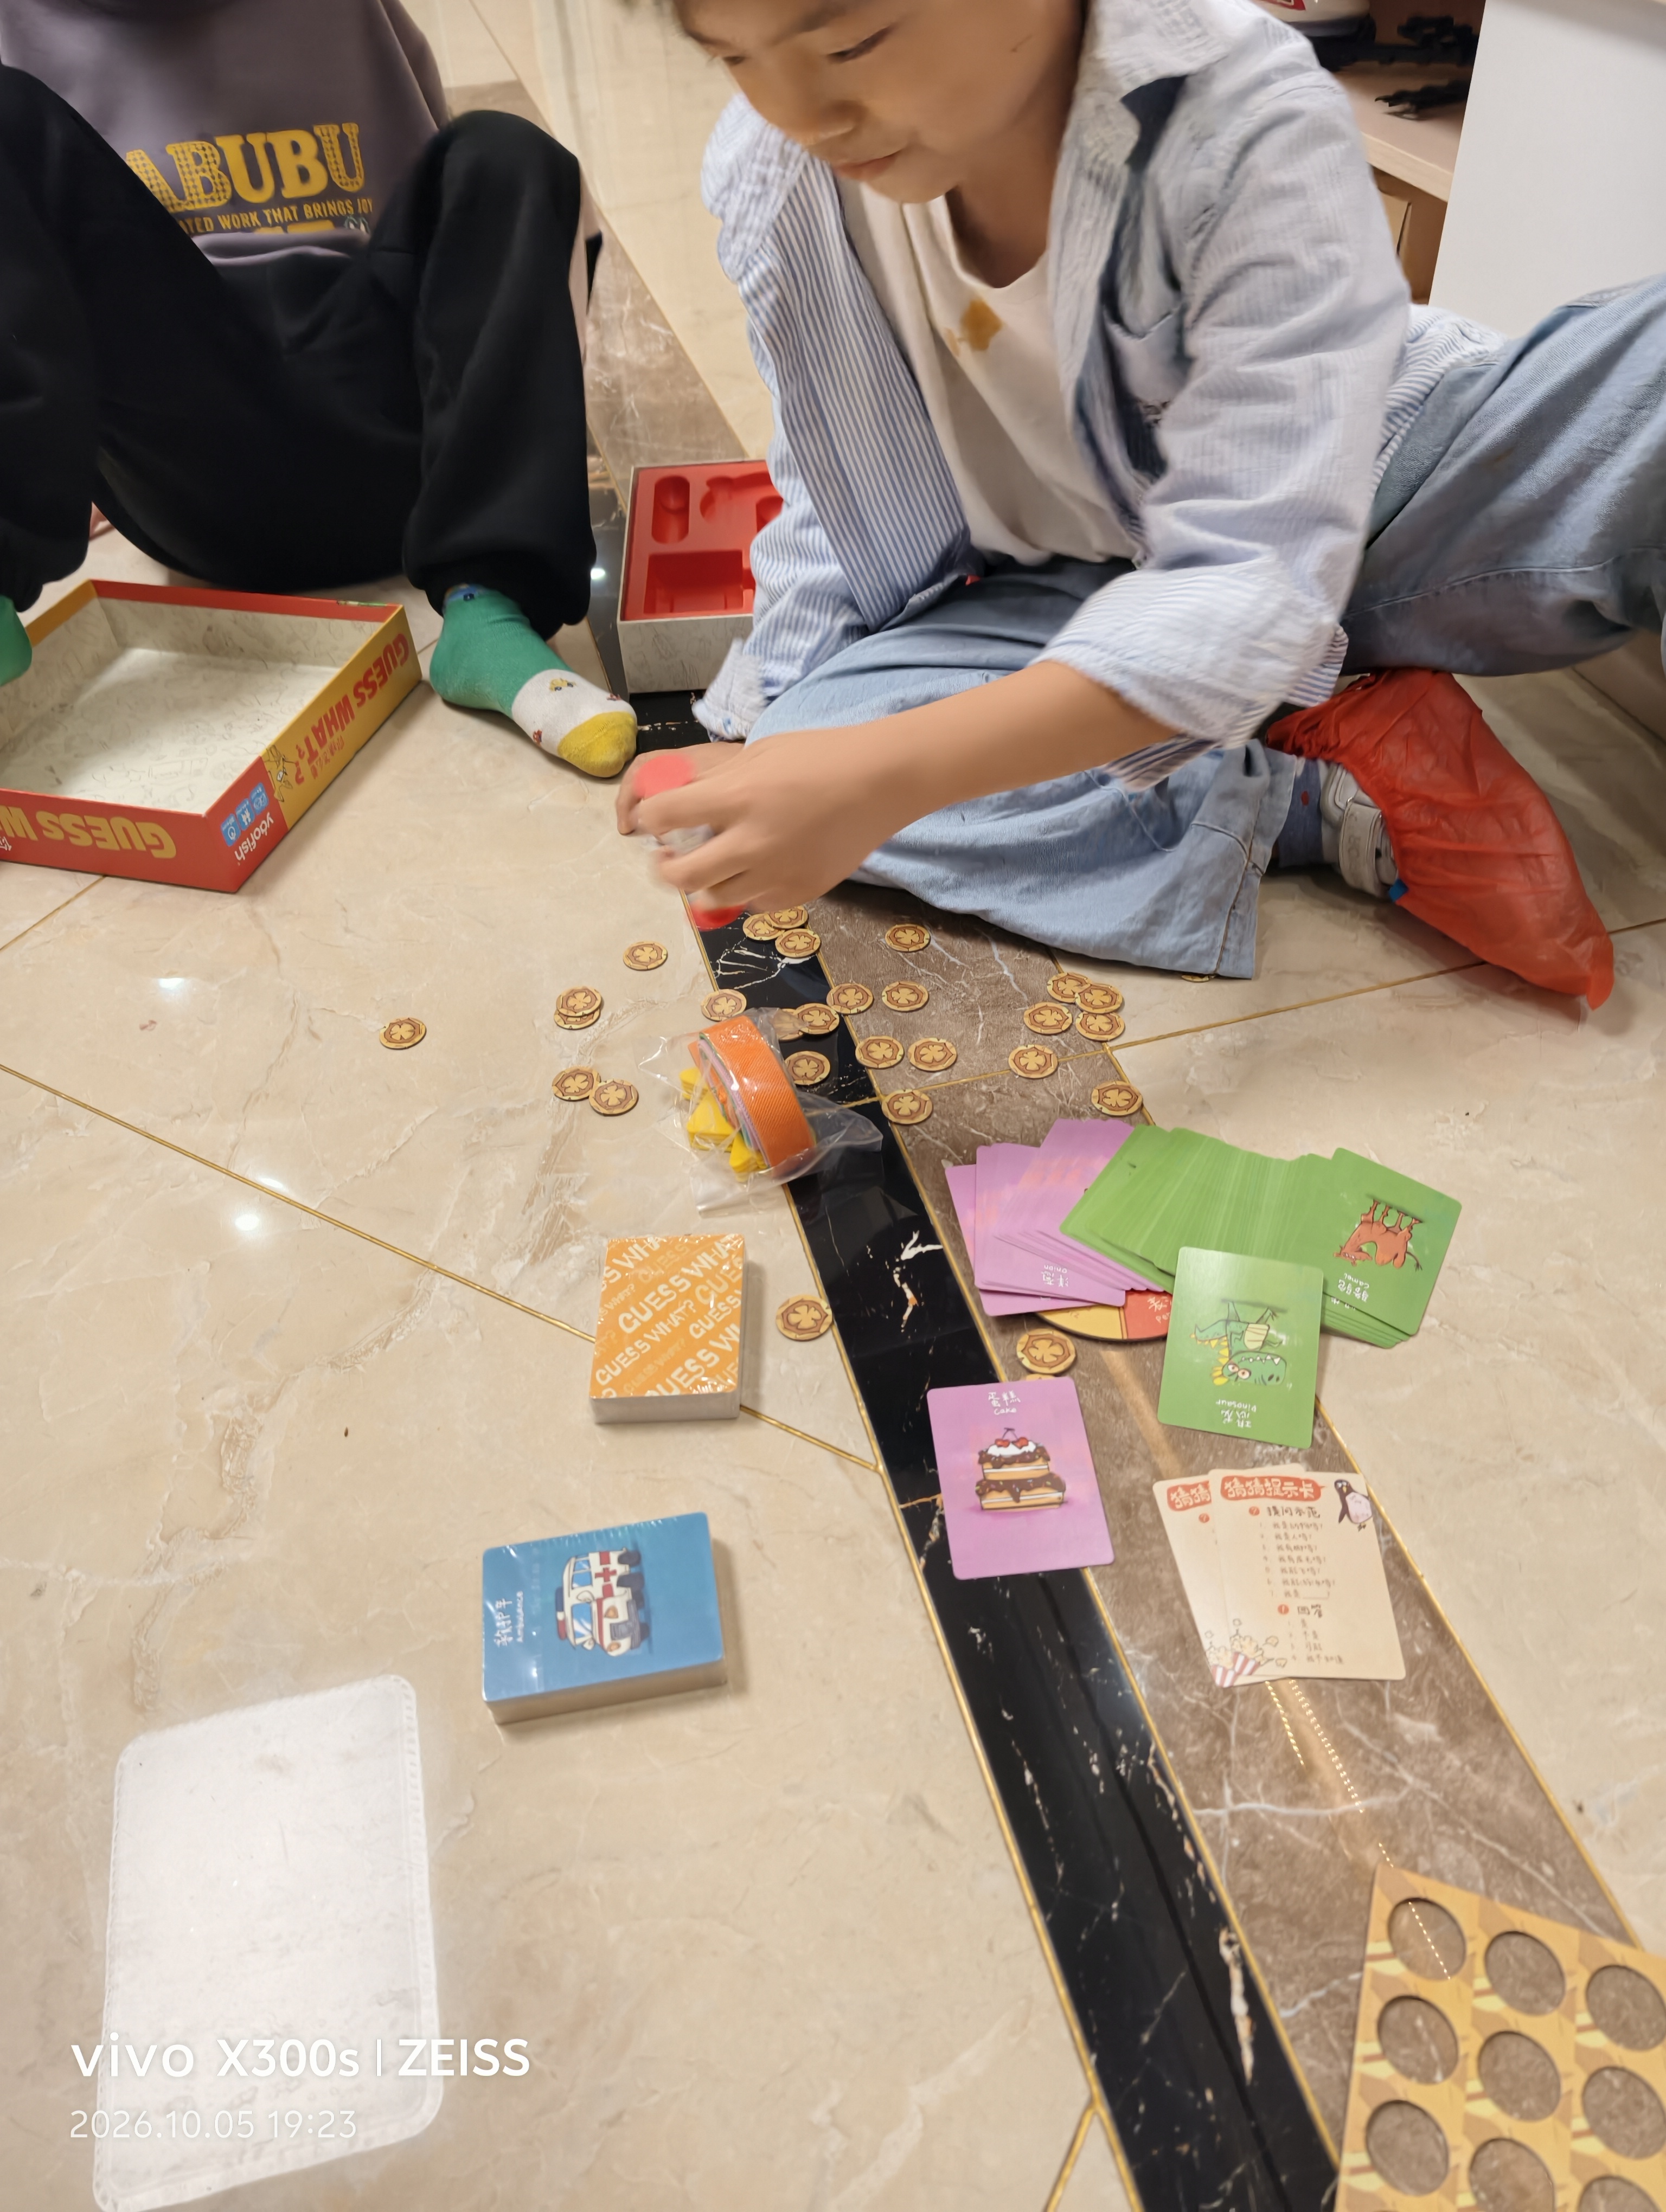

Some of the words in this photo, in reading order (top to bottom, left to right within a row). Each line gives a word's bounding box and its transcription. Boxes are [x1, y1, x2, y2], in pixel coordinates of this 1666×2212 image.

[217, 211, 261, 230] WORK
[262, 205, 298, 226] THAT
[303, 199, 354, 220] BRINGS
[357, 198, 373, 214] JOY
[353, 633, 409, 708] GUESS
[35, 811, 177, 859] GUESS
[618, 1274, 691, 1334] GUESS
[689, 1295, 741, 1339] GUESS
[595, 1339, 651, 1386] GUESS
[643, 1299, 697, 1342] WHAT?
[988, 1390, 1021, 1407] 蛋糕
[994, 1407, 1017, 1416] Cake
[1215, 1399, 1257, 1413] Dinosaur
[1170, 1480, 1212, 1509] 猜猜
[1224, 1476, 1314, 1499] 猜猜提示卡
